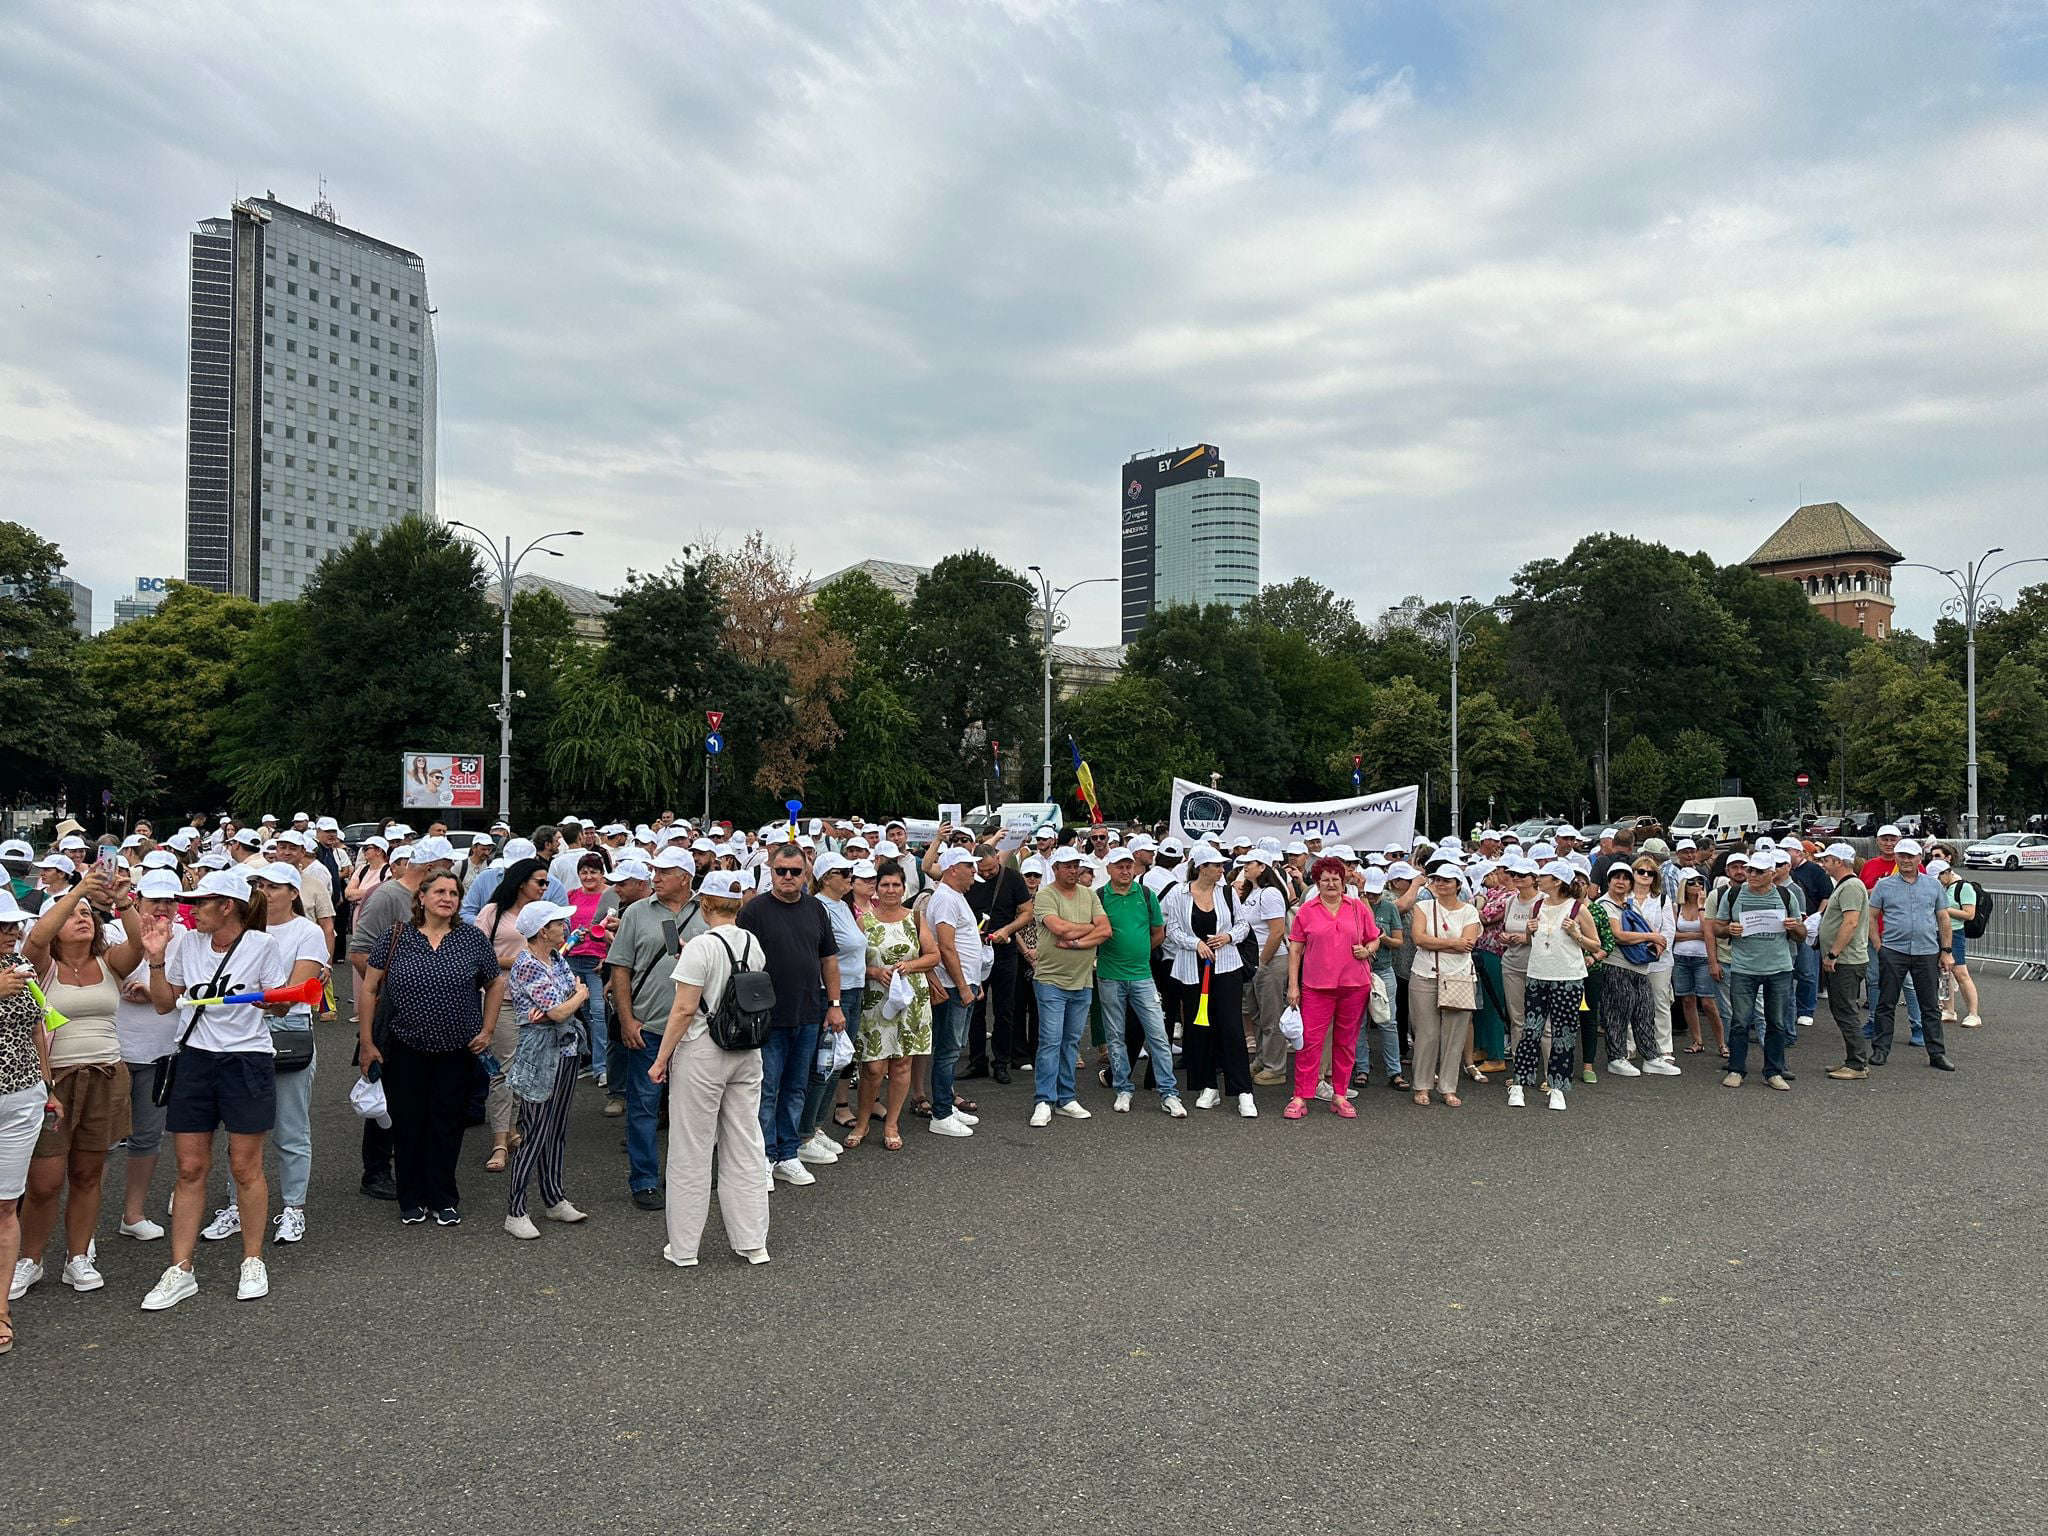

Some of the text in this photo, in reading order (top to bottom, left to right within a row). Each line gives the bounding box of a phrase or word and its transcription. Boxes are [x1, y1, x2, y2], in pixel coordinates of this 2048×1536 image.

[1158, 459, 1172, 473] EY
[1207, 469, 1216, 478] EY
[138, 577, 166, 592] BC
[449, 772, 478, 784] sale
[1237, 805, 1322, 819] SINDICATUL
[1289, 819, 1340, 836] APIA
